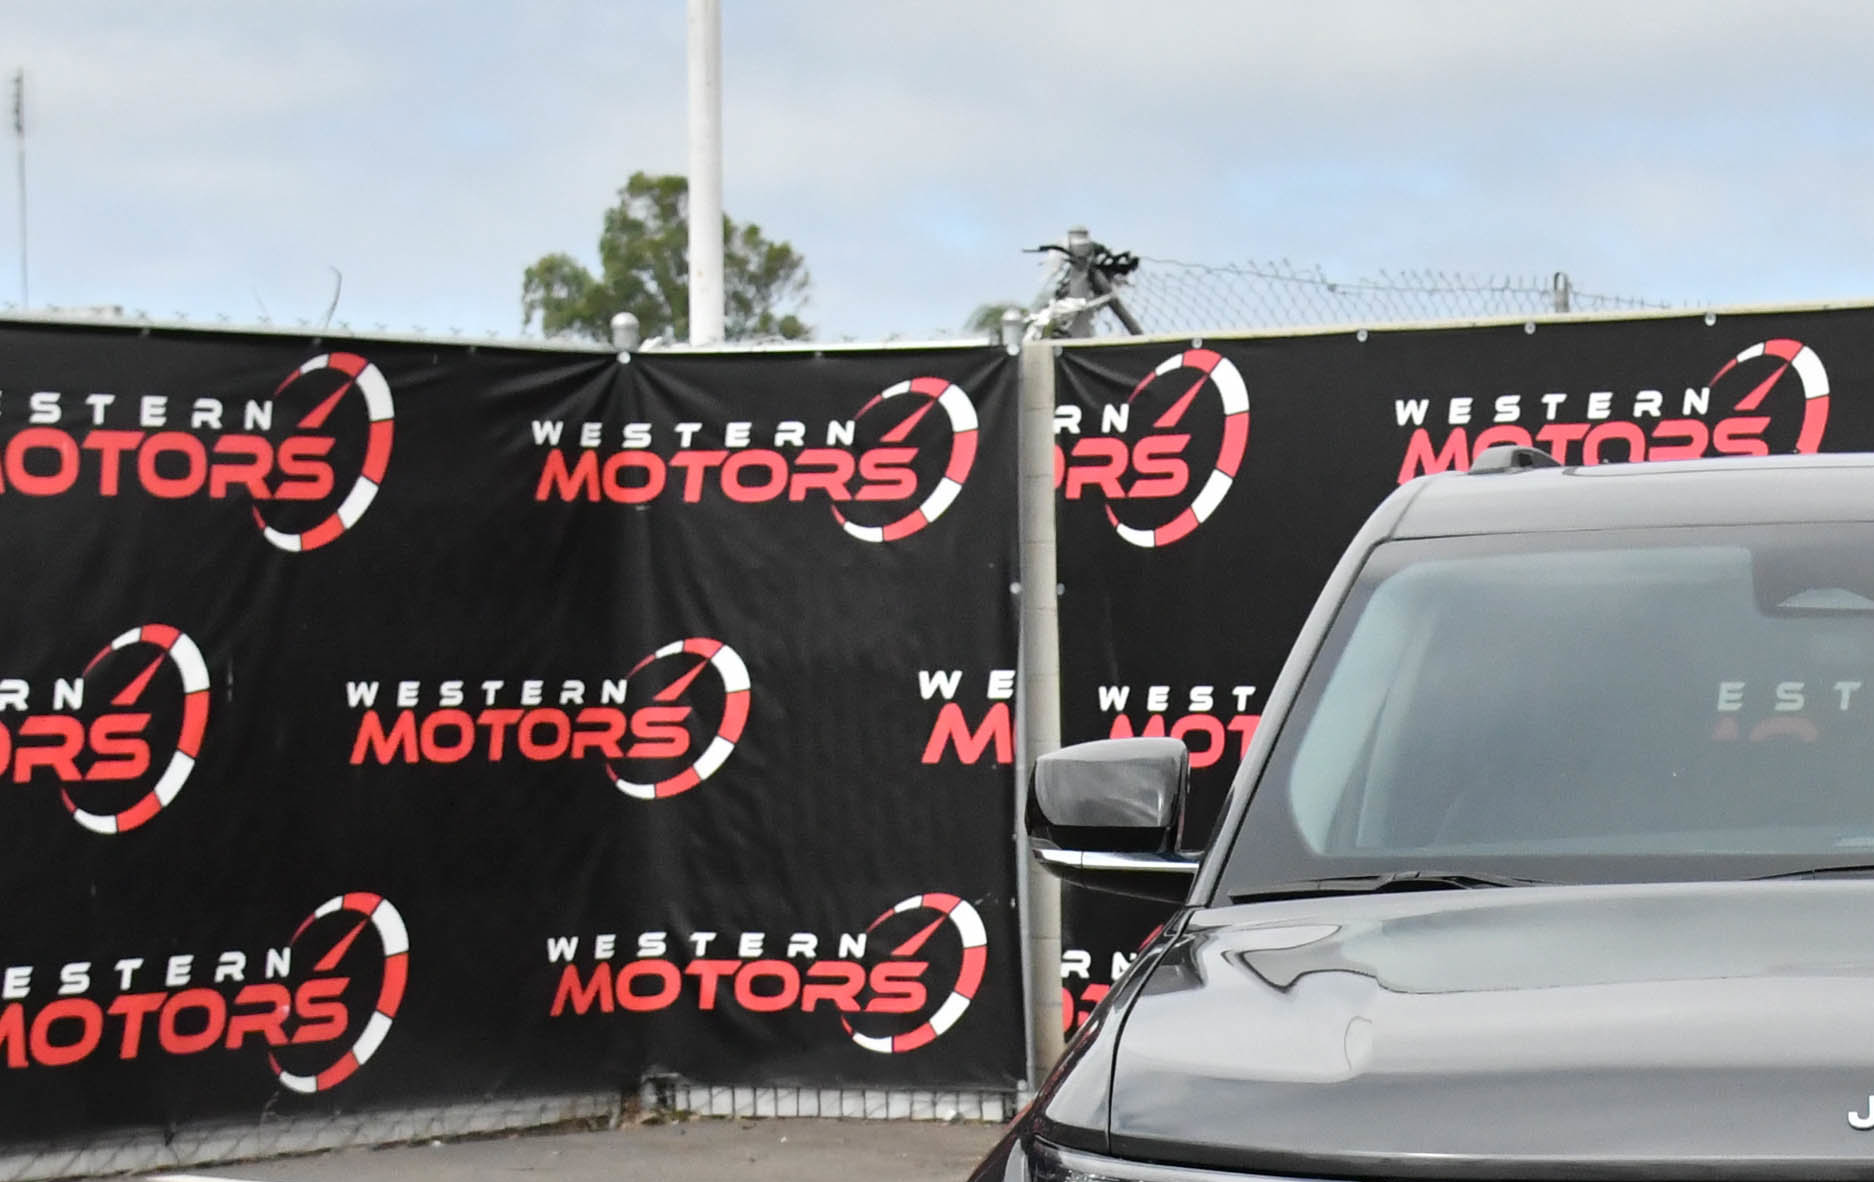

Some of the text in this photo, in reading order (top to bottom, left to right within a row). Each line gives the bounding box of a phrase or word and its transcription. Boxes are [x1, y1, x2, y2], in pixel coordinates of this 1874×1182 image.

[0, 390, 272, 431] STERN
[1395, 387, 1710, 426] WESTERN
[531, 420, 856, 449] WESTERN
[0, 427, 336, 500] OTORS
[535, 446, 919, 503] MOTORS
[346, 679, 628, 709] WESTERN
[1098, 685, 1257, 712] WEST
[349, 706, 692, 766] MOTORS
[547, 931, 867, 963] WESTERN
[2, 947, 291, 999] ESTERN
[550, 958, 929, 1017] MOTORS
